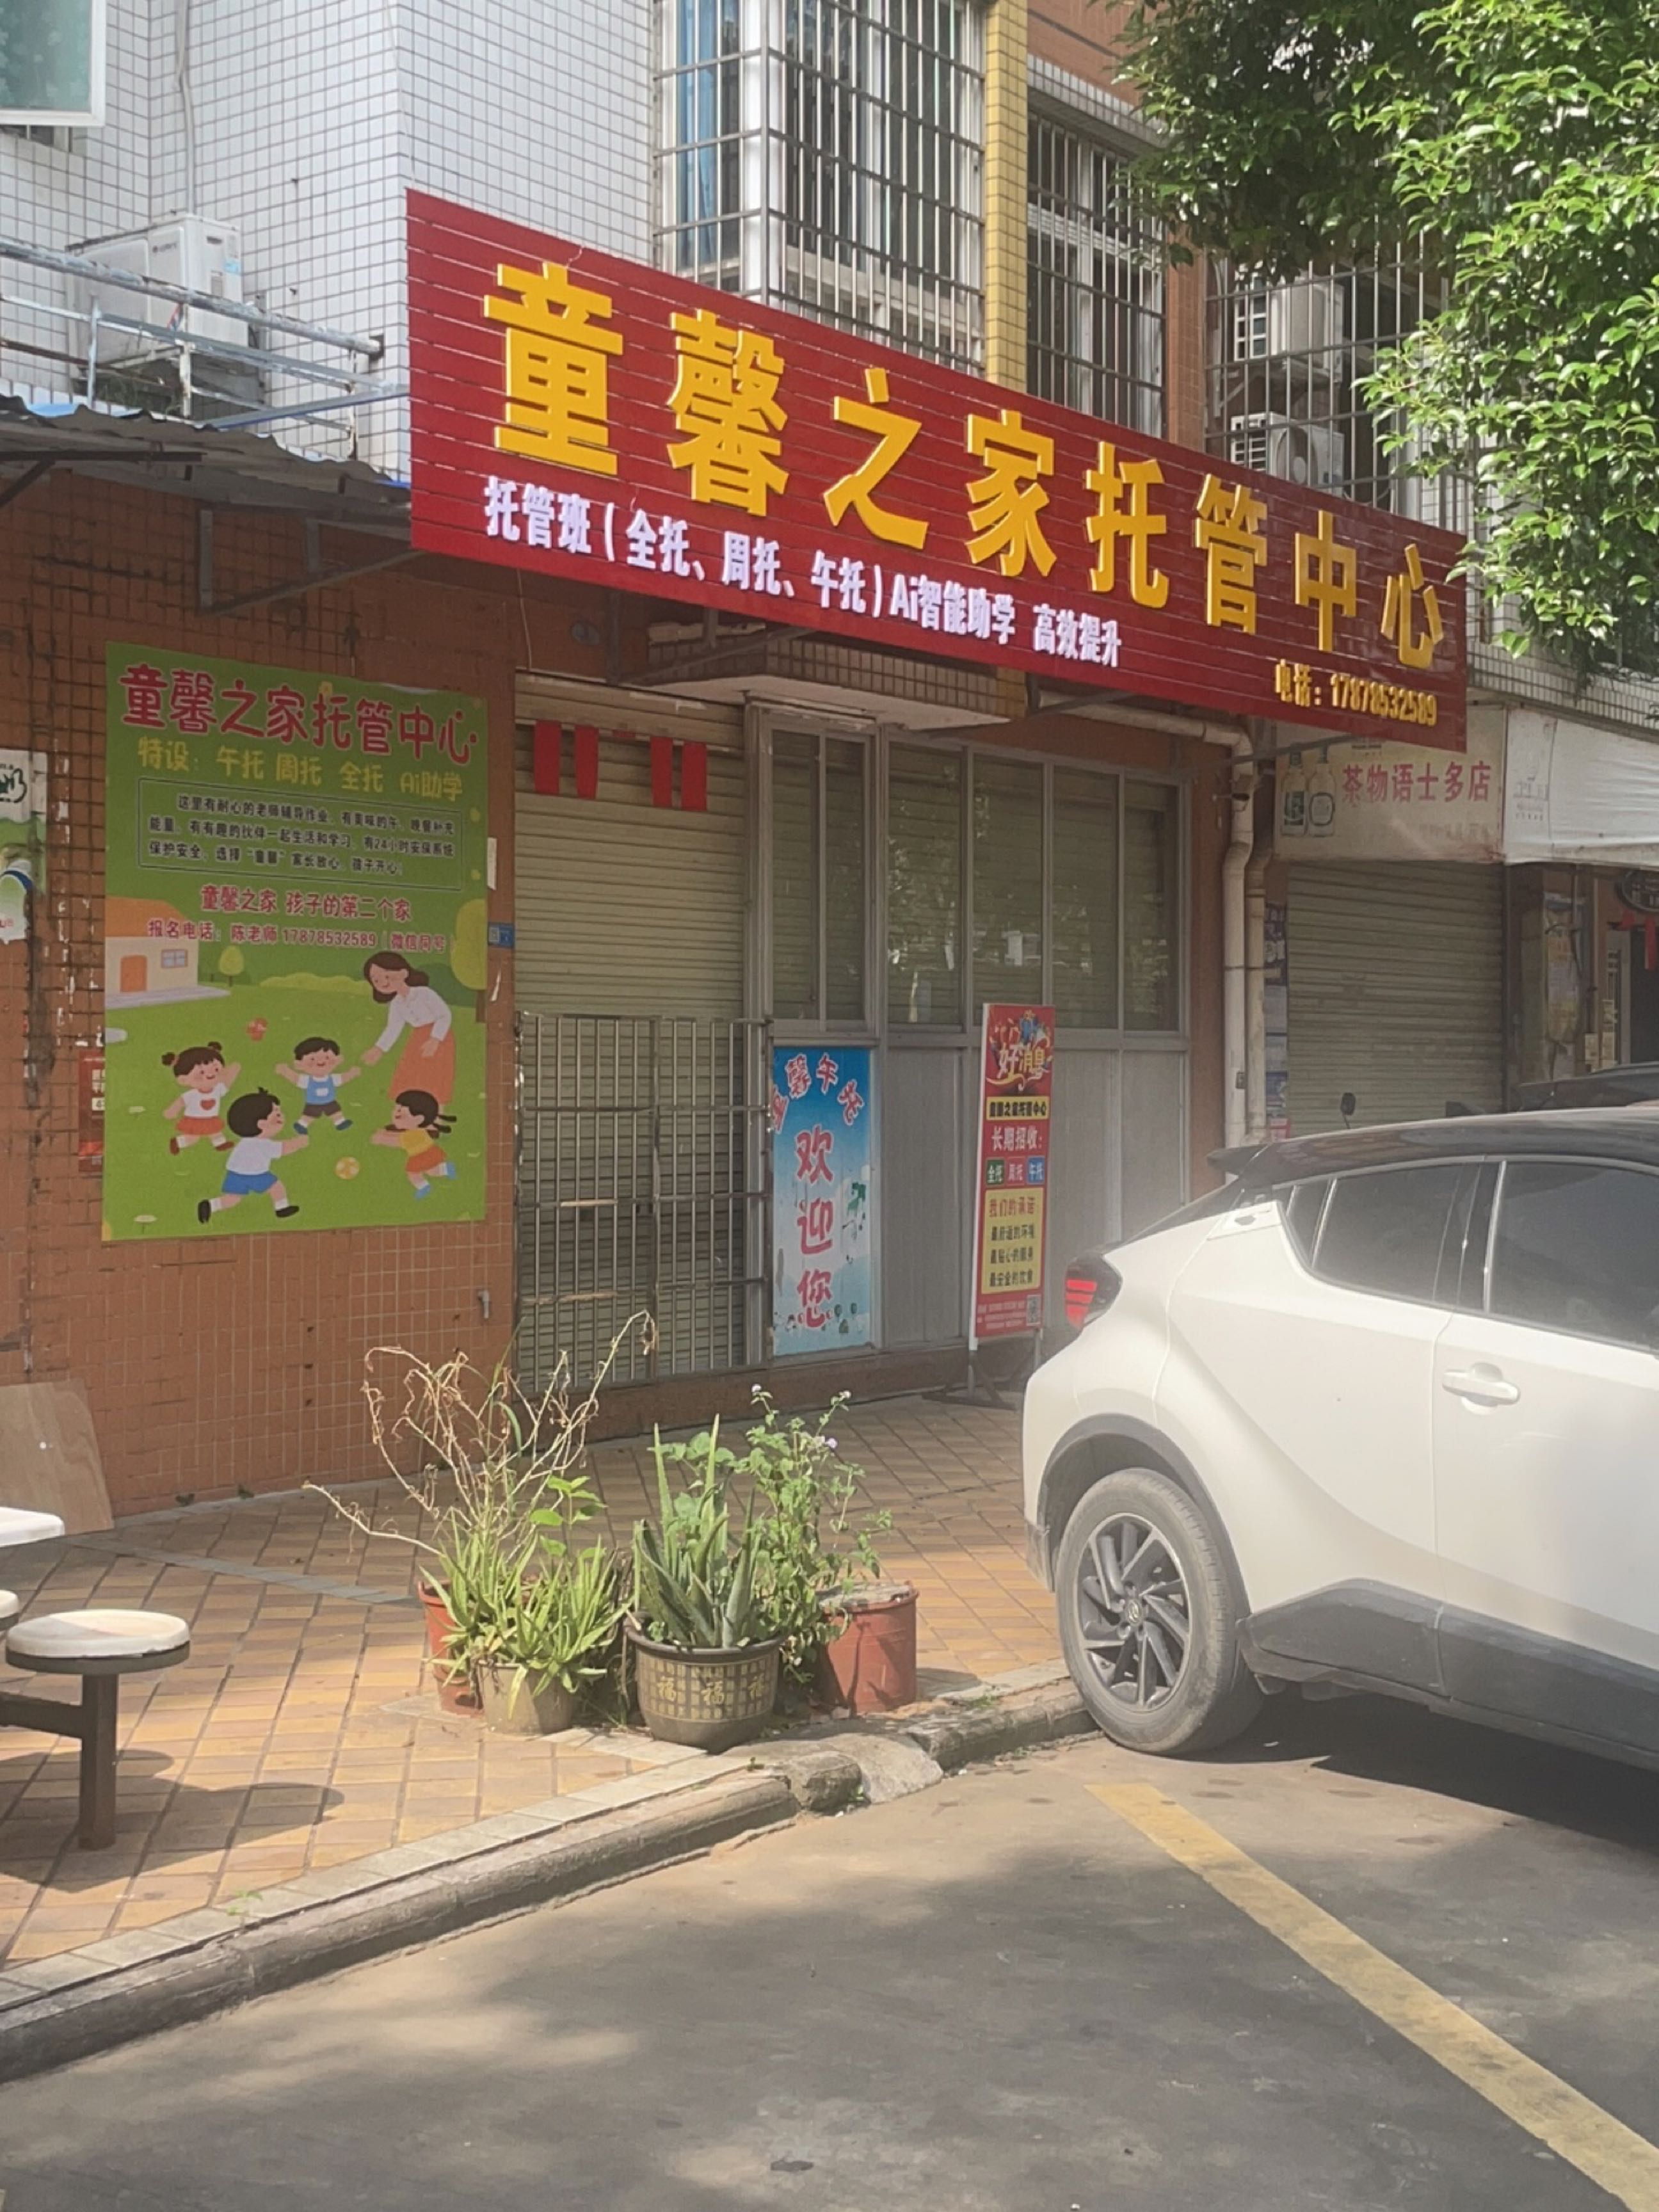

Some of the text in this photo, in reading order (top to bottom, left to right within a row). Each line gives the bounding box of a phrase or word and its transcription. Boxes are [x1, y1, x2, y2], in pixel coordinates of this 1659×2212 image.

[483, 261, 1444, 669] 童馨之家托管中心
[1032, 604, 1121, 668] 高效提升
[120, 663, 477, 765] 童馨之家托管中心
[216, 746, 264, 780] 午托
[276, 752, 322, 787] 周托
[339, 760, 383, 794] 全托
[1342, 760, 1491, 804] 茶物语士多店
[201, 885, 412, 922] 童馨之家 孩子的第二个家
[230, 924, 278, 944] 陈老师
[282, 929, 376, 947] 17878532589
[986, 1043, 1050, 1091] 好消息
[701, 1681, 725, 1706] 福
